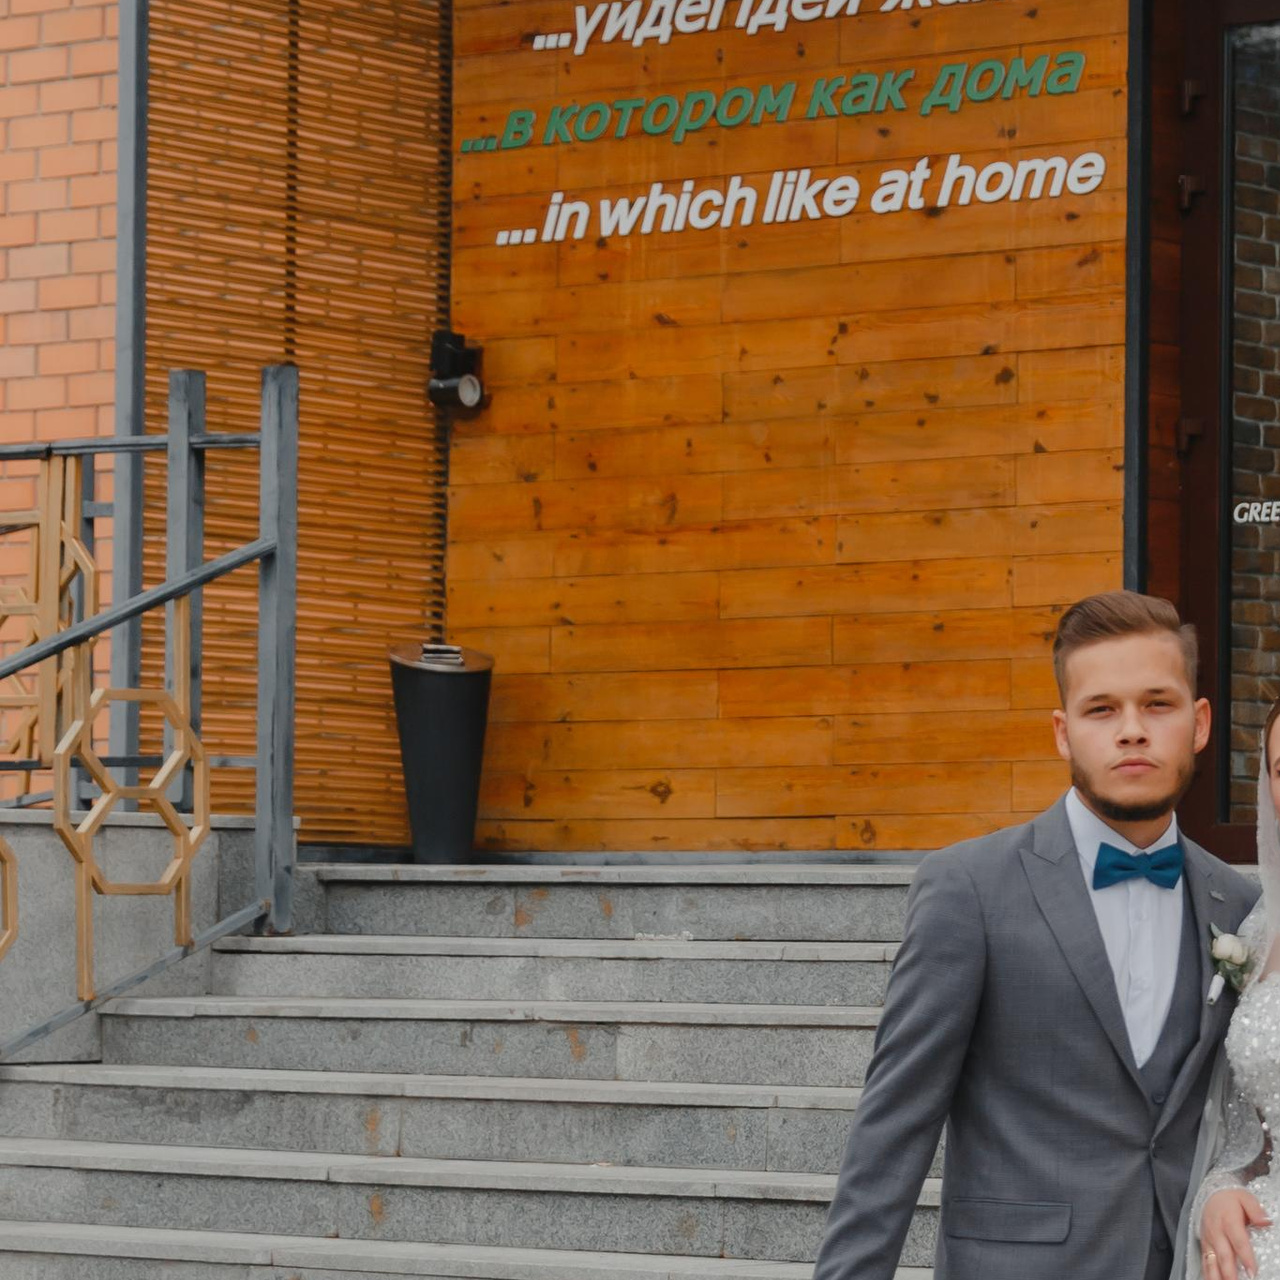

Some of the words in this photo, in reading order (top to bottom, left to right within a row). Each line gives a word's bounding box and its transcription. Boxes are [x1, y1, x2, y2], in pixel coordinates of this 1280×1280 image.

[542, 82, 797, 145] котором
[807, 69, 915, 119] как
[919, 51, 1086, 117] дома
[599, 175, 758, 238] which
[762, 168, 861, 224] like
[870, 156, 932, 214] at
[936, 151, 1107, 207] home
